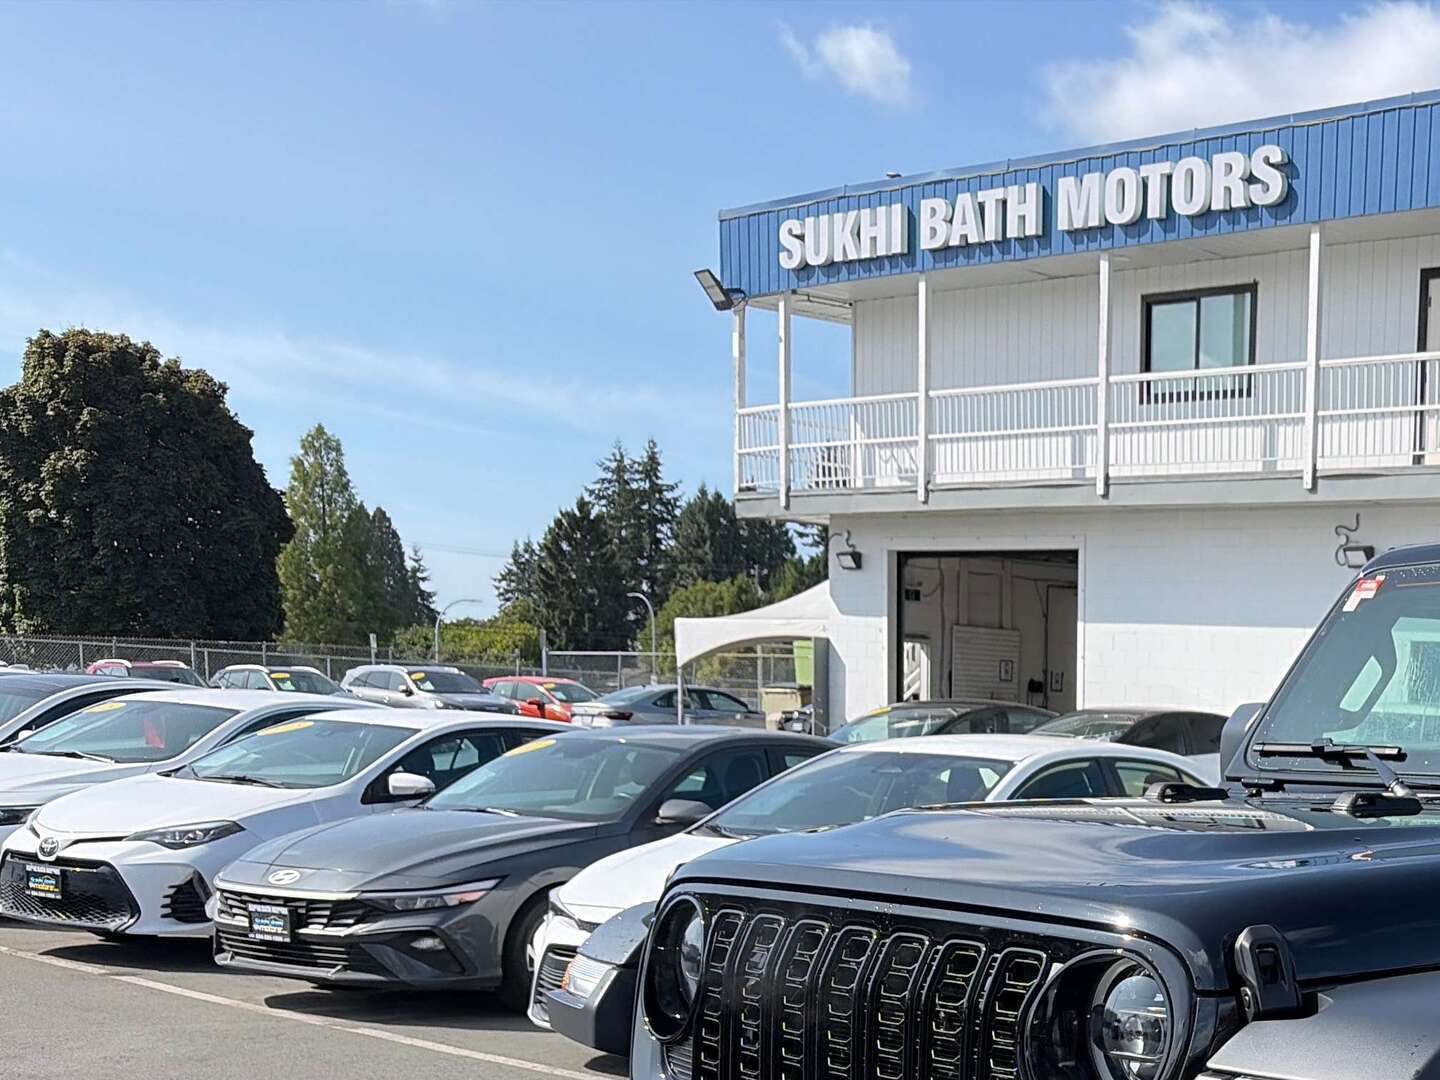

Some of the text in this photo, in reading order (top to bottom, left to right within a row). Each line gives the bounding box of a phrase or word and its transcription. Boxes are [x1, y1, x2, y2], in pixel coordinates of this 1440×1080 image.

[779, 144, 1290, 270] SUKHI BATH MOTORS
